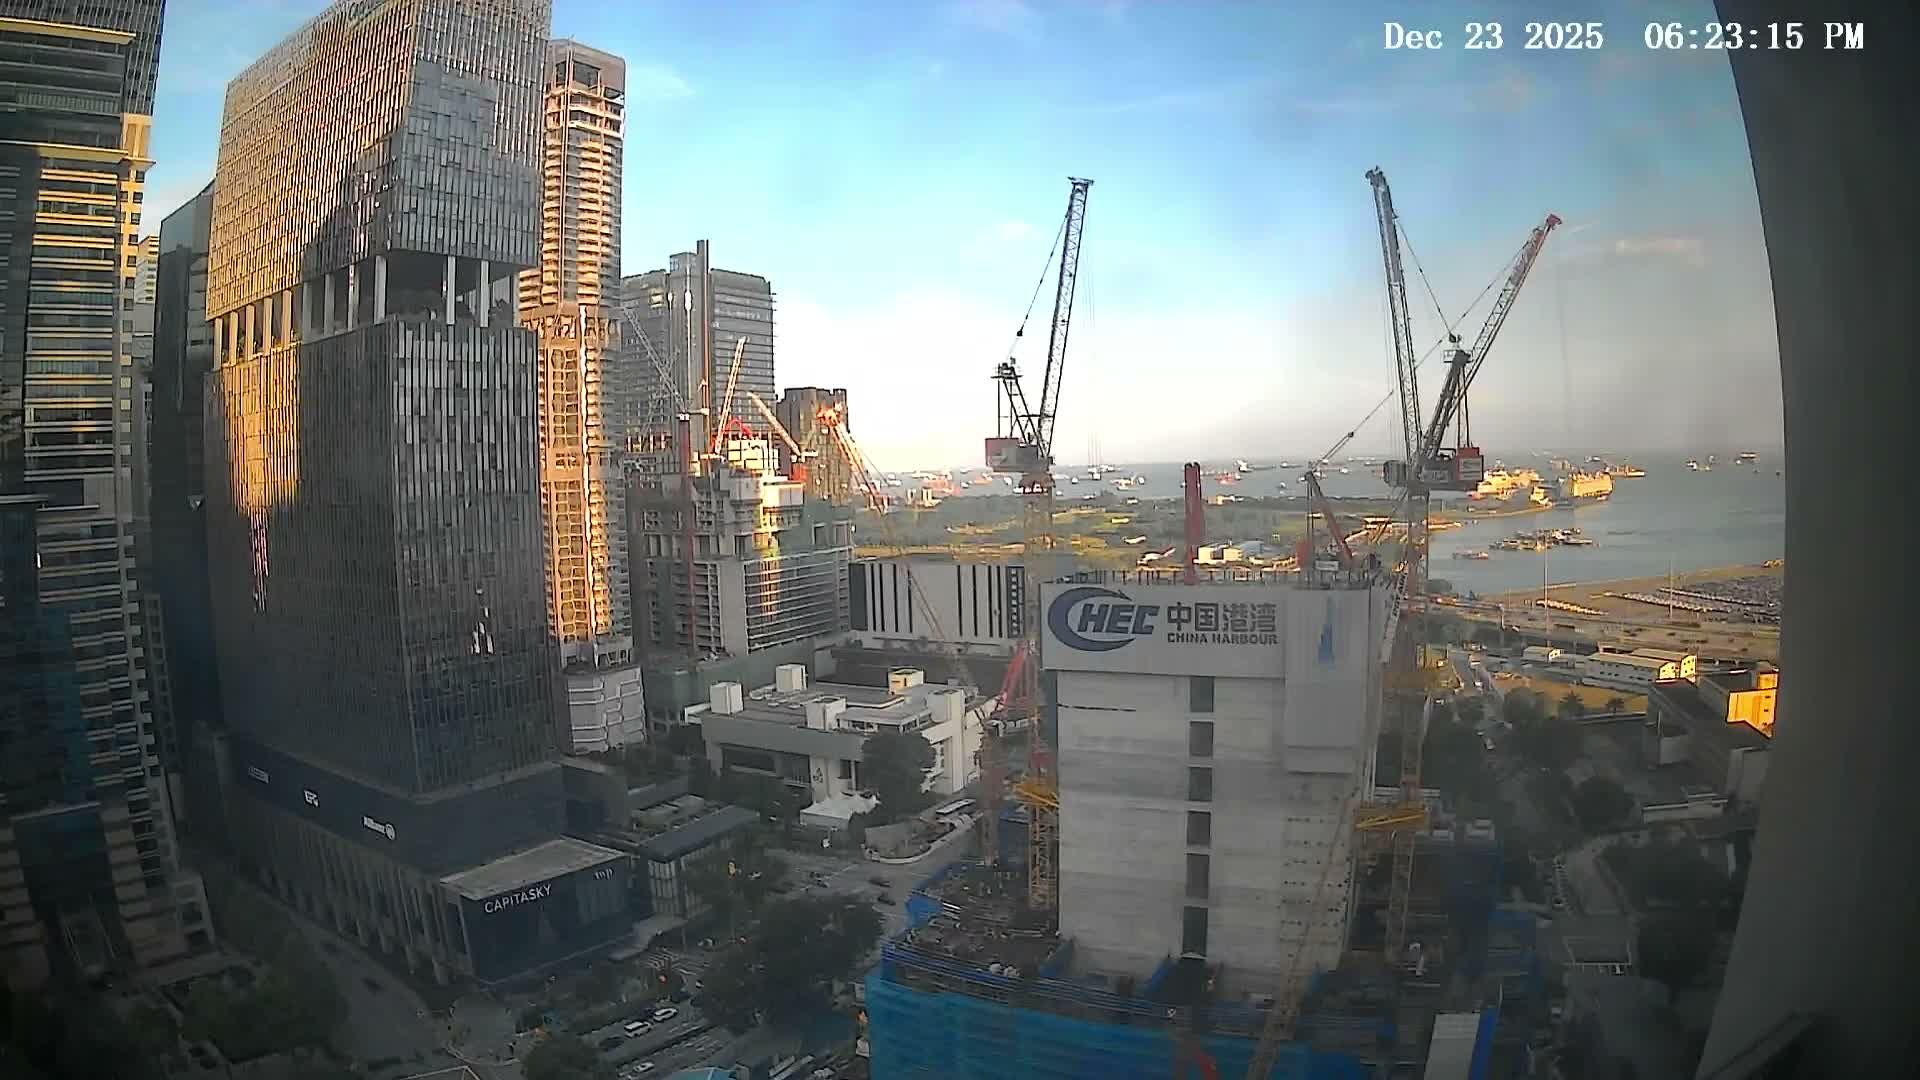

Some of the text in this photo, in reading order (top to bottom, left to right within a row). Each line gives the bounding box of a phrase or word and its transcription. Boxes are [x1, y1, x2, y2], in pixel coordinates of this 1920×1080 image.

[1167, 601, 1277, 633] 中国港湾
[1167, 632, 1279, 645] CHINA HARBOUR
[484, 883, 552, 913] CAPITASKY
